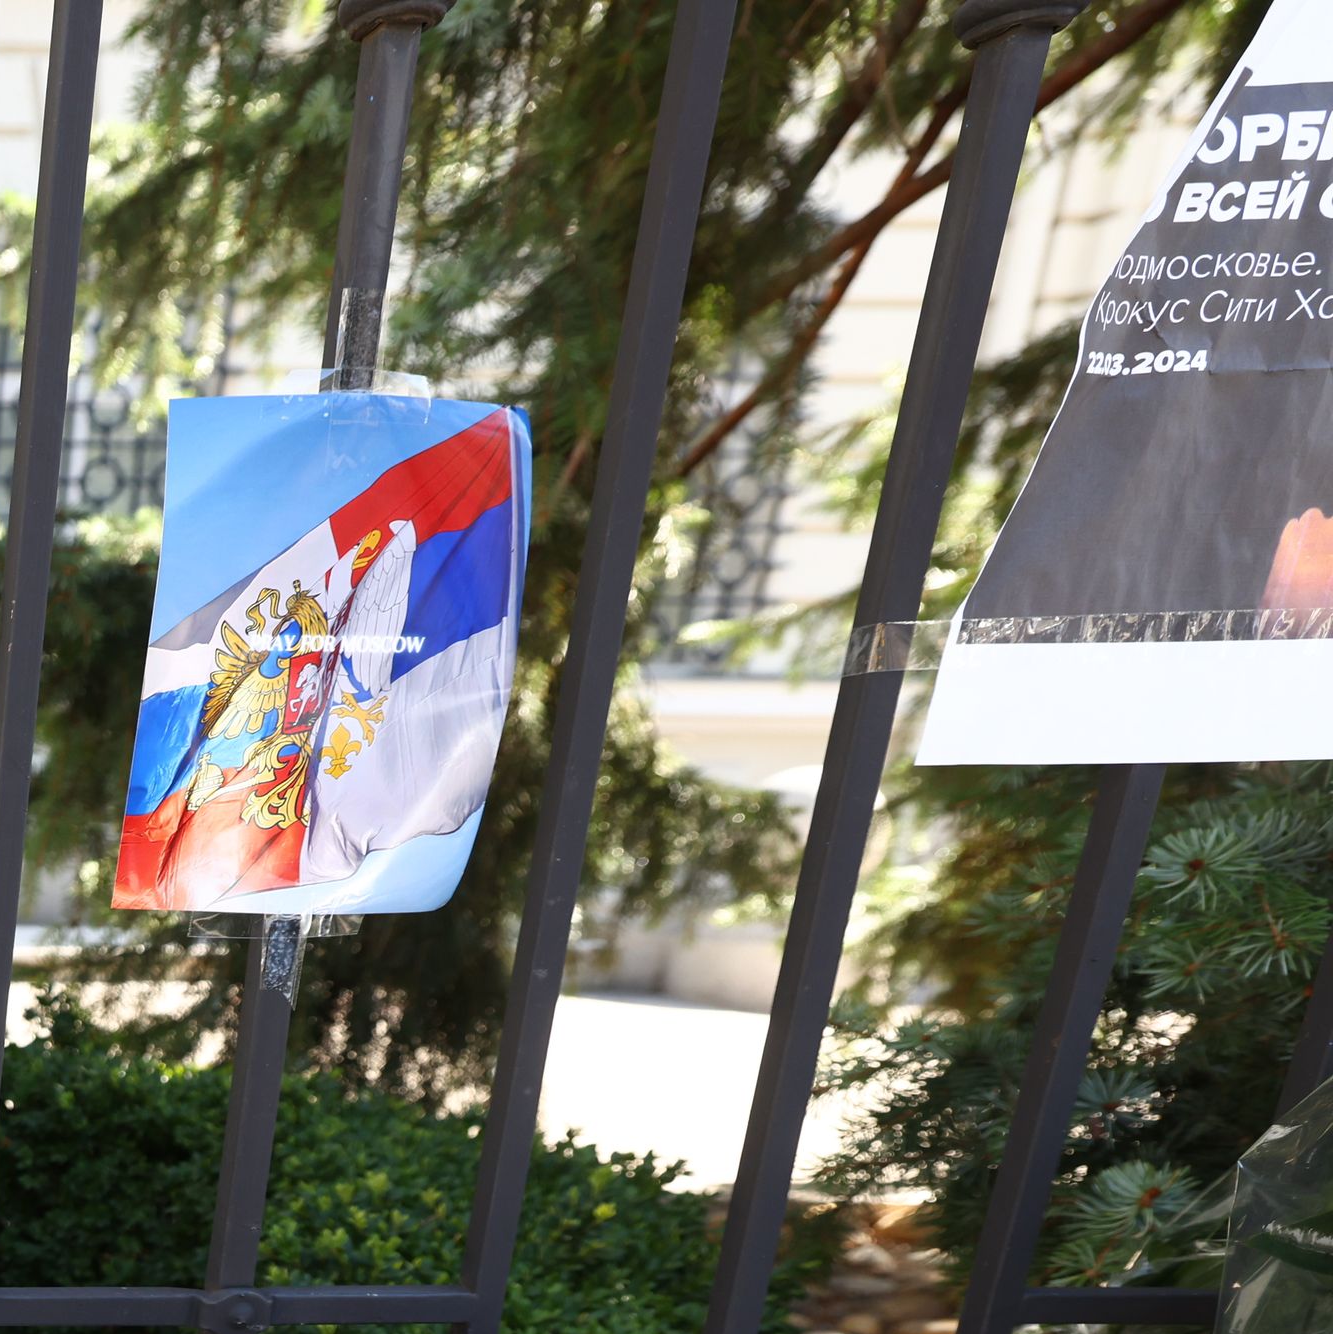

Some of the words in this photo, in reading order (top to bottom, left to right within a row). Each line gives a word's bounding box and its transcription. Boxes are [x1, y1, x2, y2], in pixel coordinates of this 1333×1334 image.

[1195, 110, 1333, 165] ОРБ
[1172, 170, 1311, 223] ВСЕЙ
[1095, 291, 1191, 332] Крокус
[1199, 289, 1278, 324] Сити
[248, 634, 297, 652] PRAY
[299, 634, 336, 652] FOR
[338, 635, 426, 654] MOSCOW
